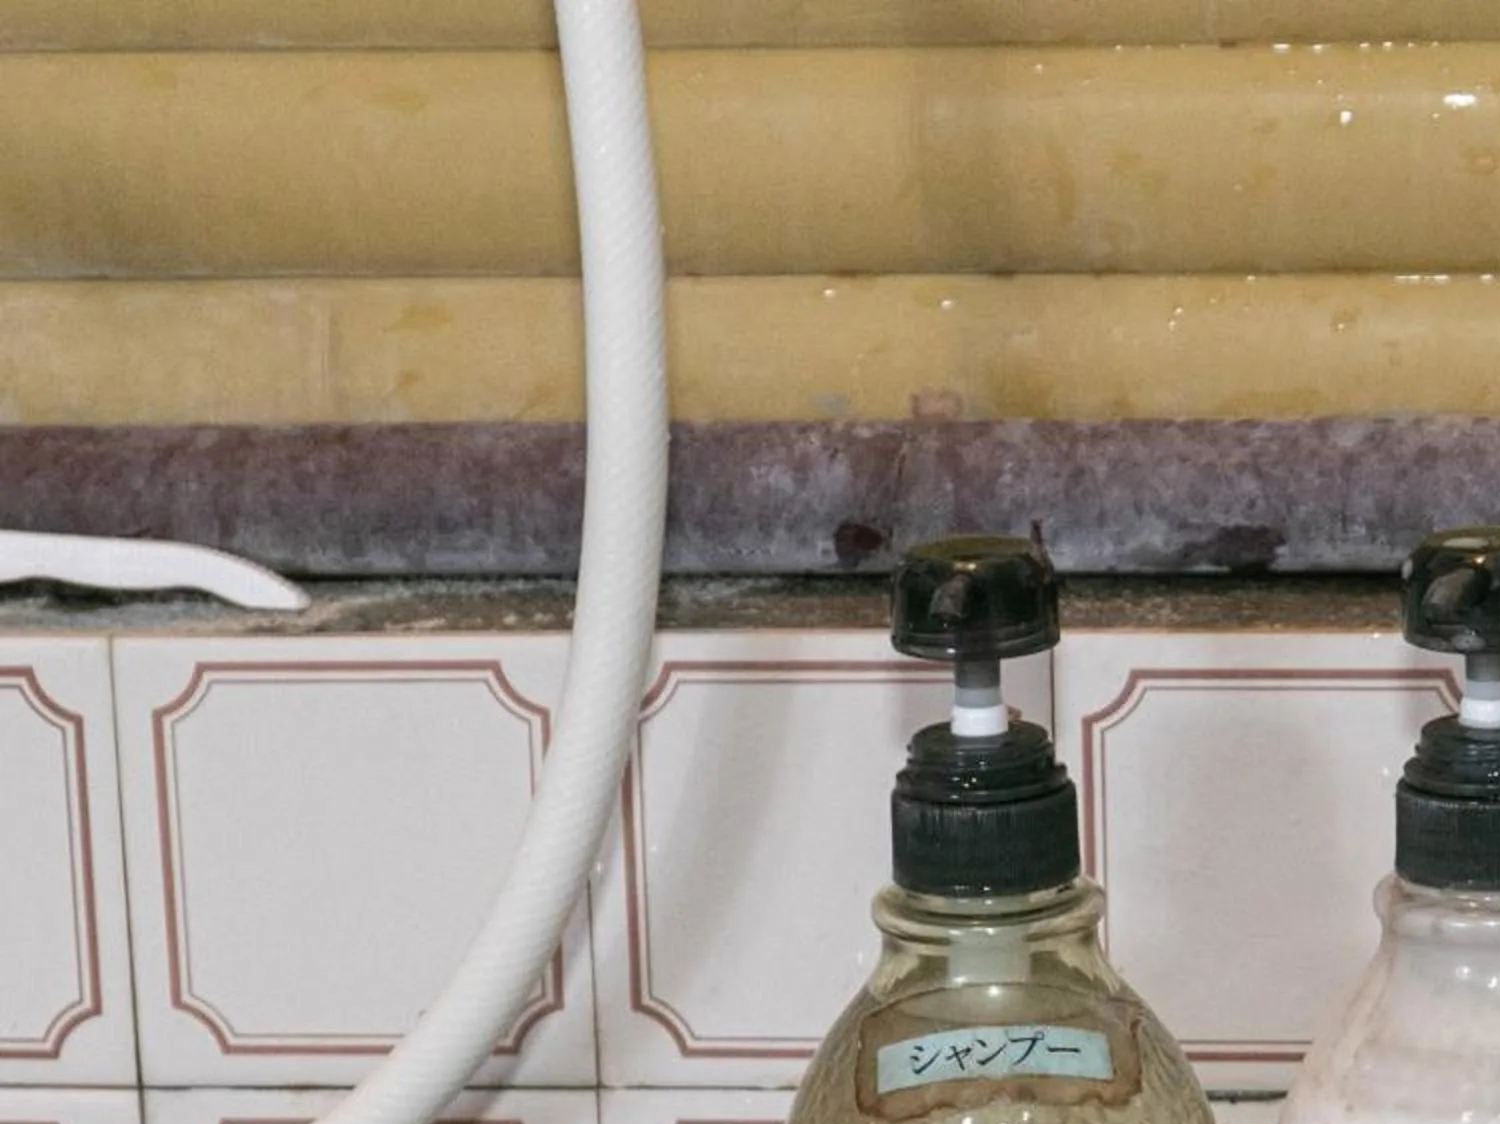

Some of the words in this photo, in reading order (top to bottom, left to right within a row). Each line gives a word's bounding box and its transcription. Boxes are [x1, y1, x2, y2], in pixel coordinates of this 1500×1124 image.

[909, 1031, 1081, 1075] シャンプー
